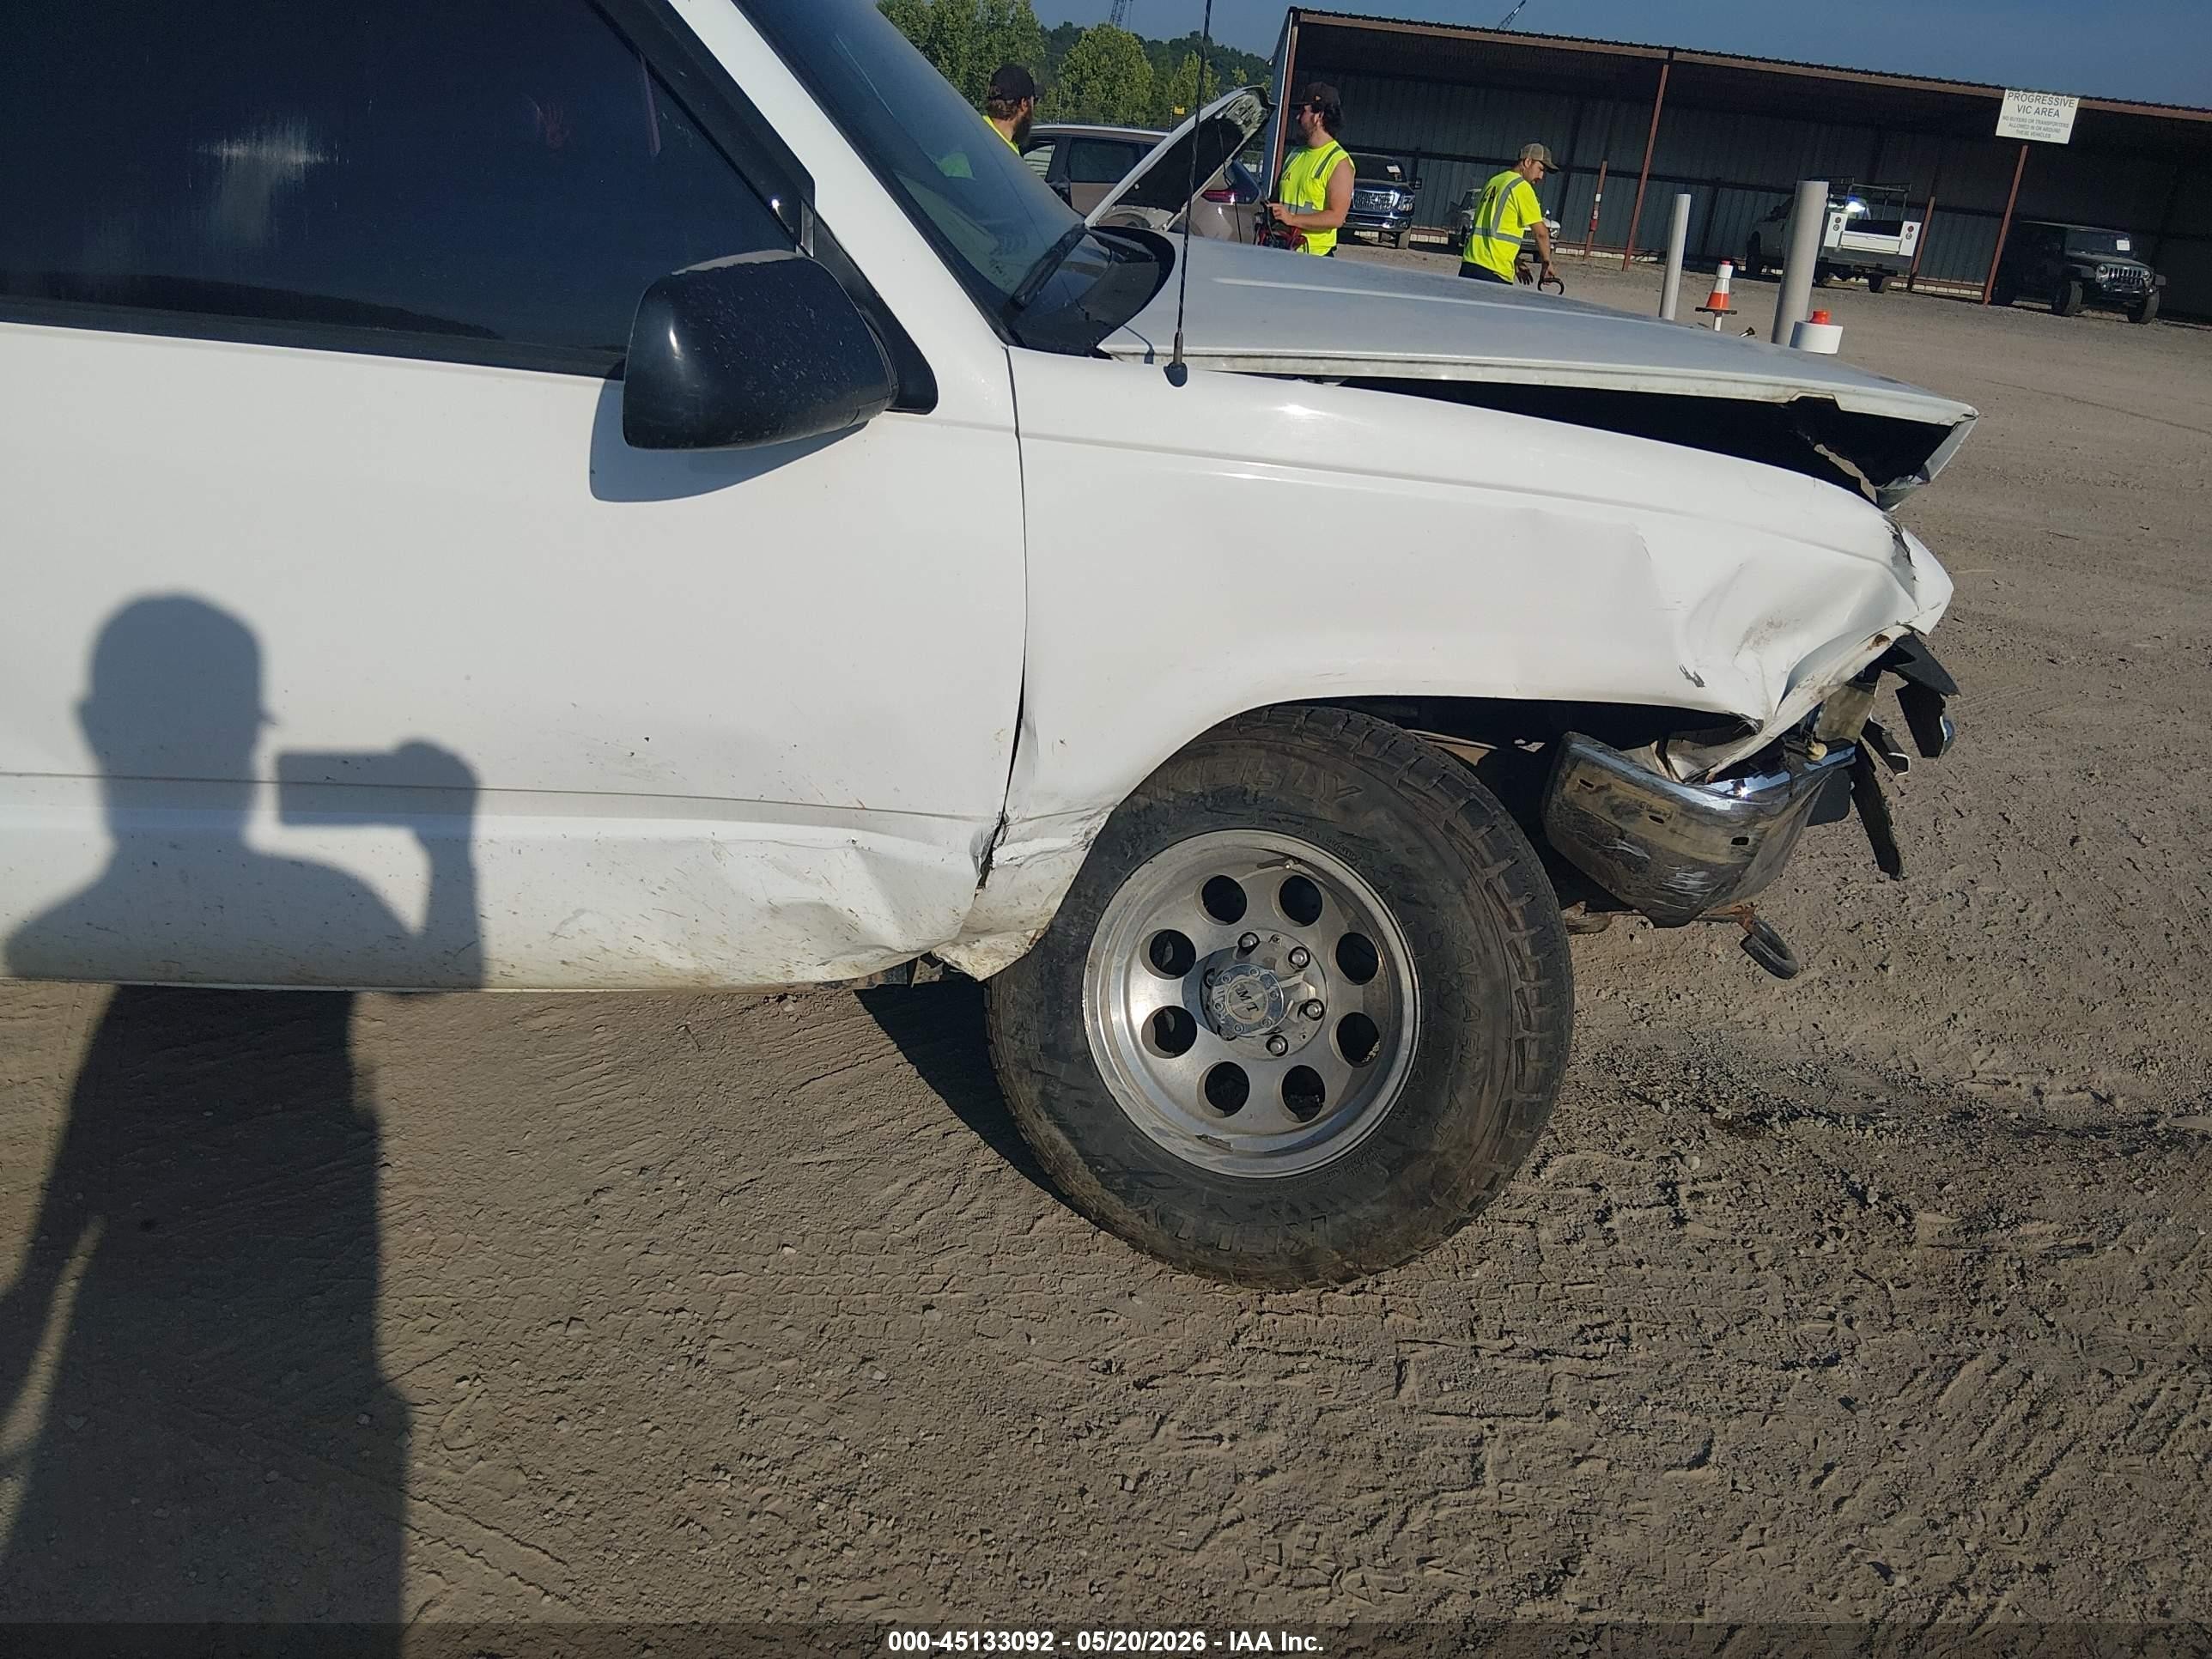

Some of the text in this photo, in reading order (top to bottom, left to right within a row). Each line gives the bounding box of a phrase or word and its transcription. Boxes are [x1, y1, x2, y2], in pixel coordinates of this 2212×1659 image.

[2007, 92, 2075, 108] PROGRESSIVE
[2017, 104, 2060, 118] VIC AREA
